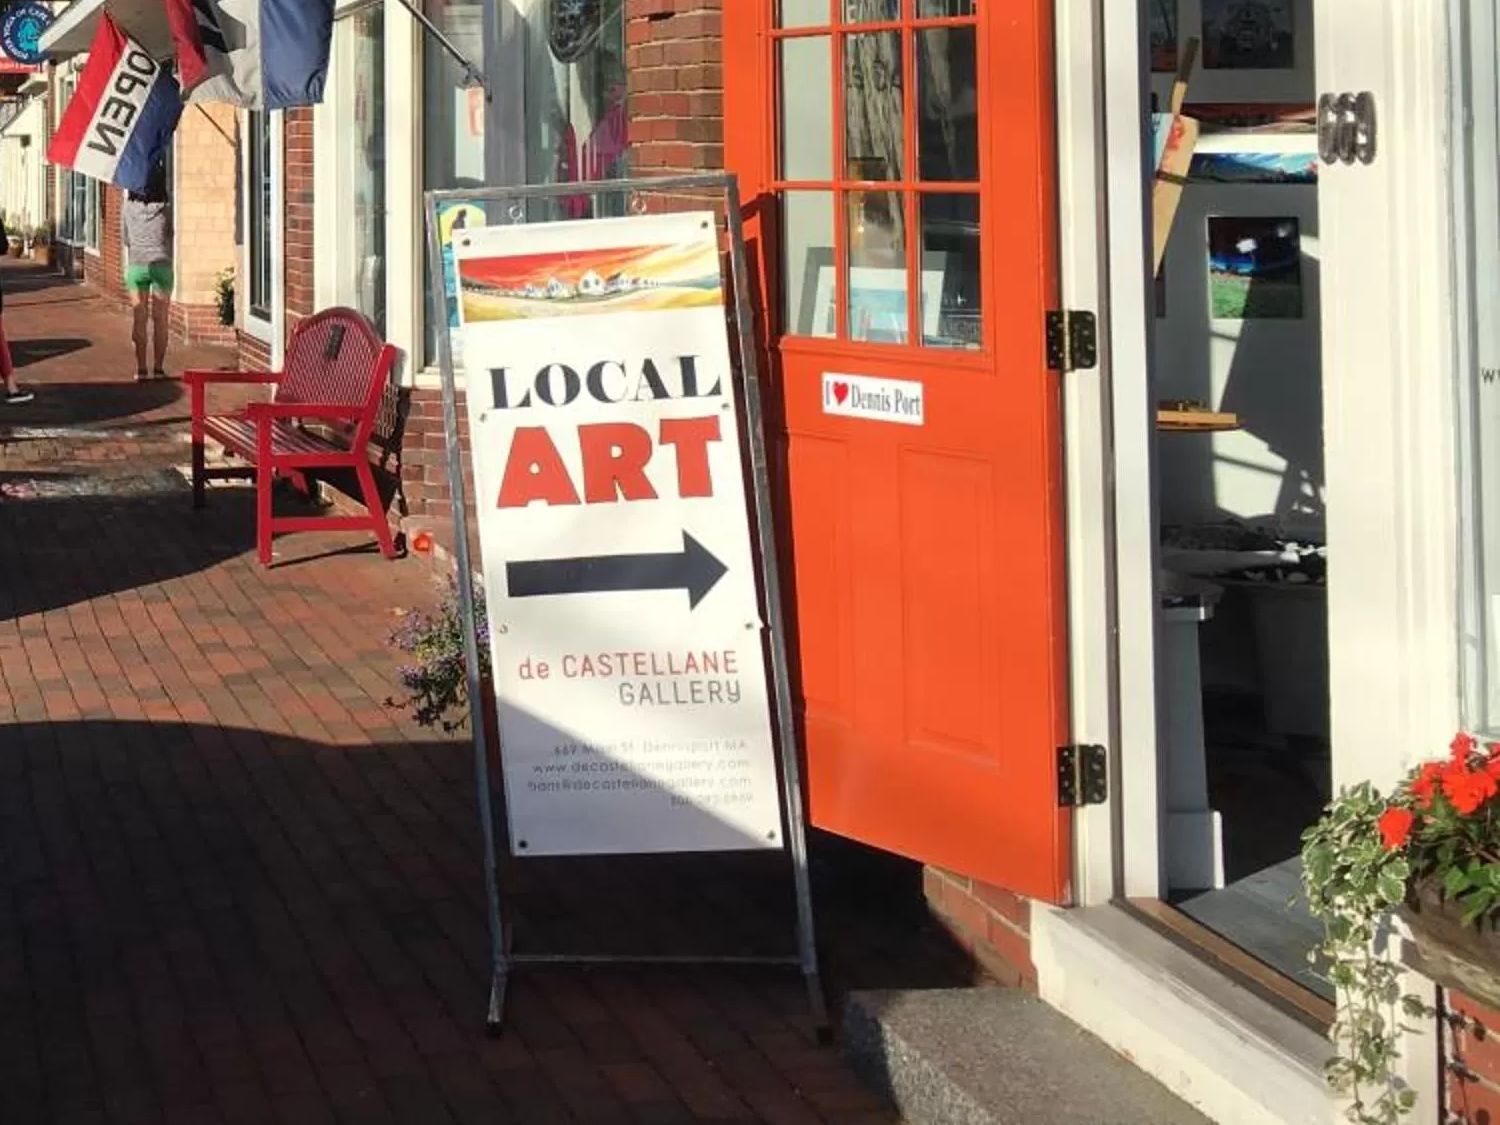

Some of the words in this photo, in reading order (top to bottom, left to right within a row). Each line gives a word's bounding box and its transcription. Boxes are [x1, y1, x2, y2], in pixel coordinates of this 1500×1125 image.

[485, 355, 722, 409] LOCAL
[852, 384, 891, 412] Dennis
[894, 388, 920, 415] Port
[496, 415, 723, 509] ART
[519, 655, 549, 679] de
[563, 650, 738, 678] CASTELLANE
[619, 679, 741, 706] GALLERY
